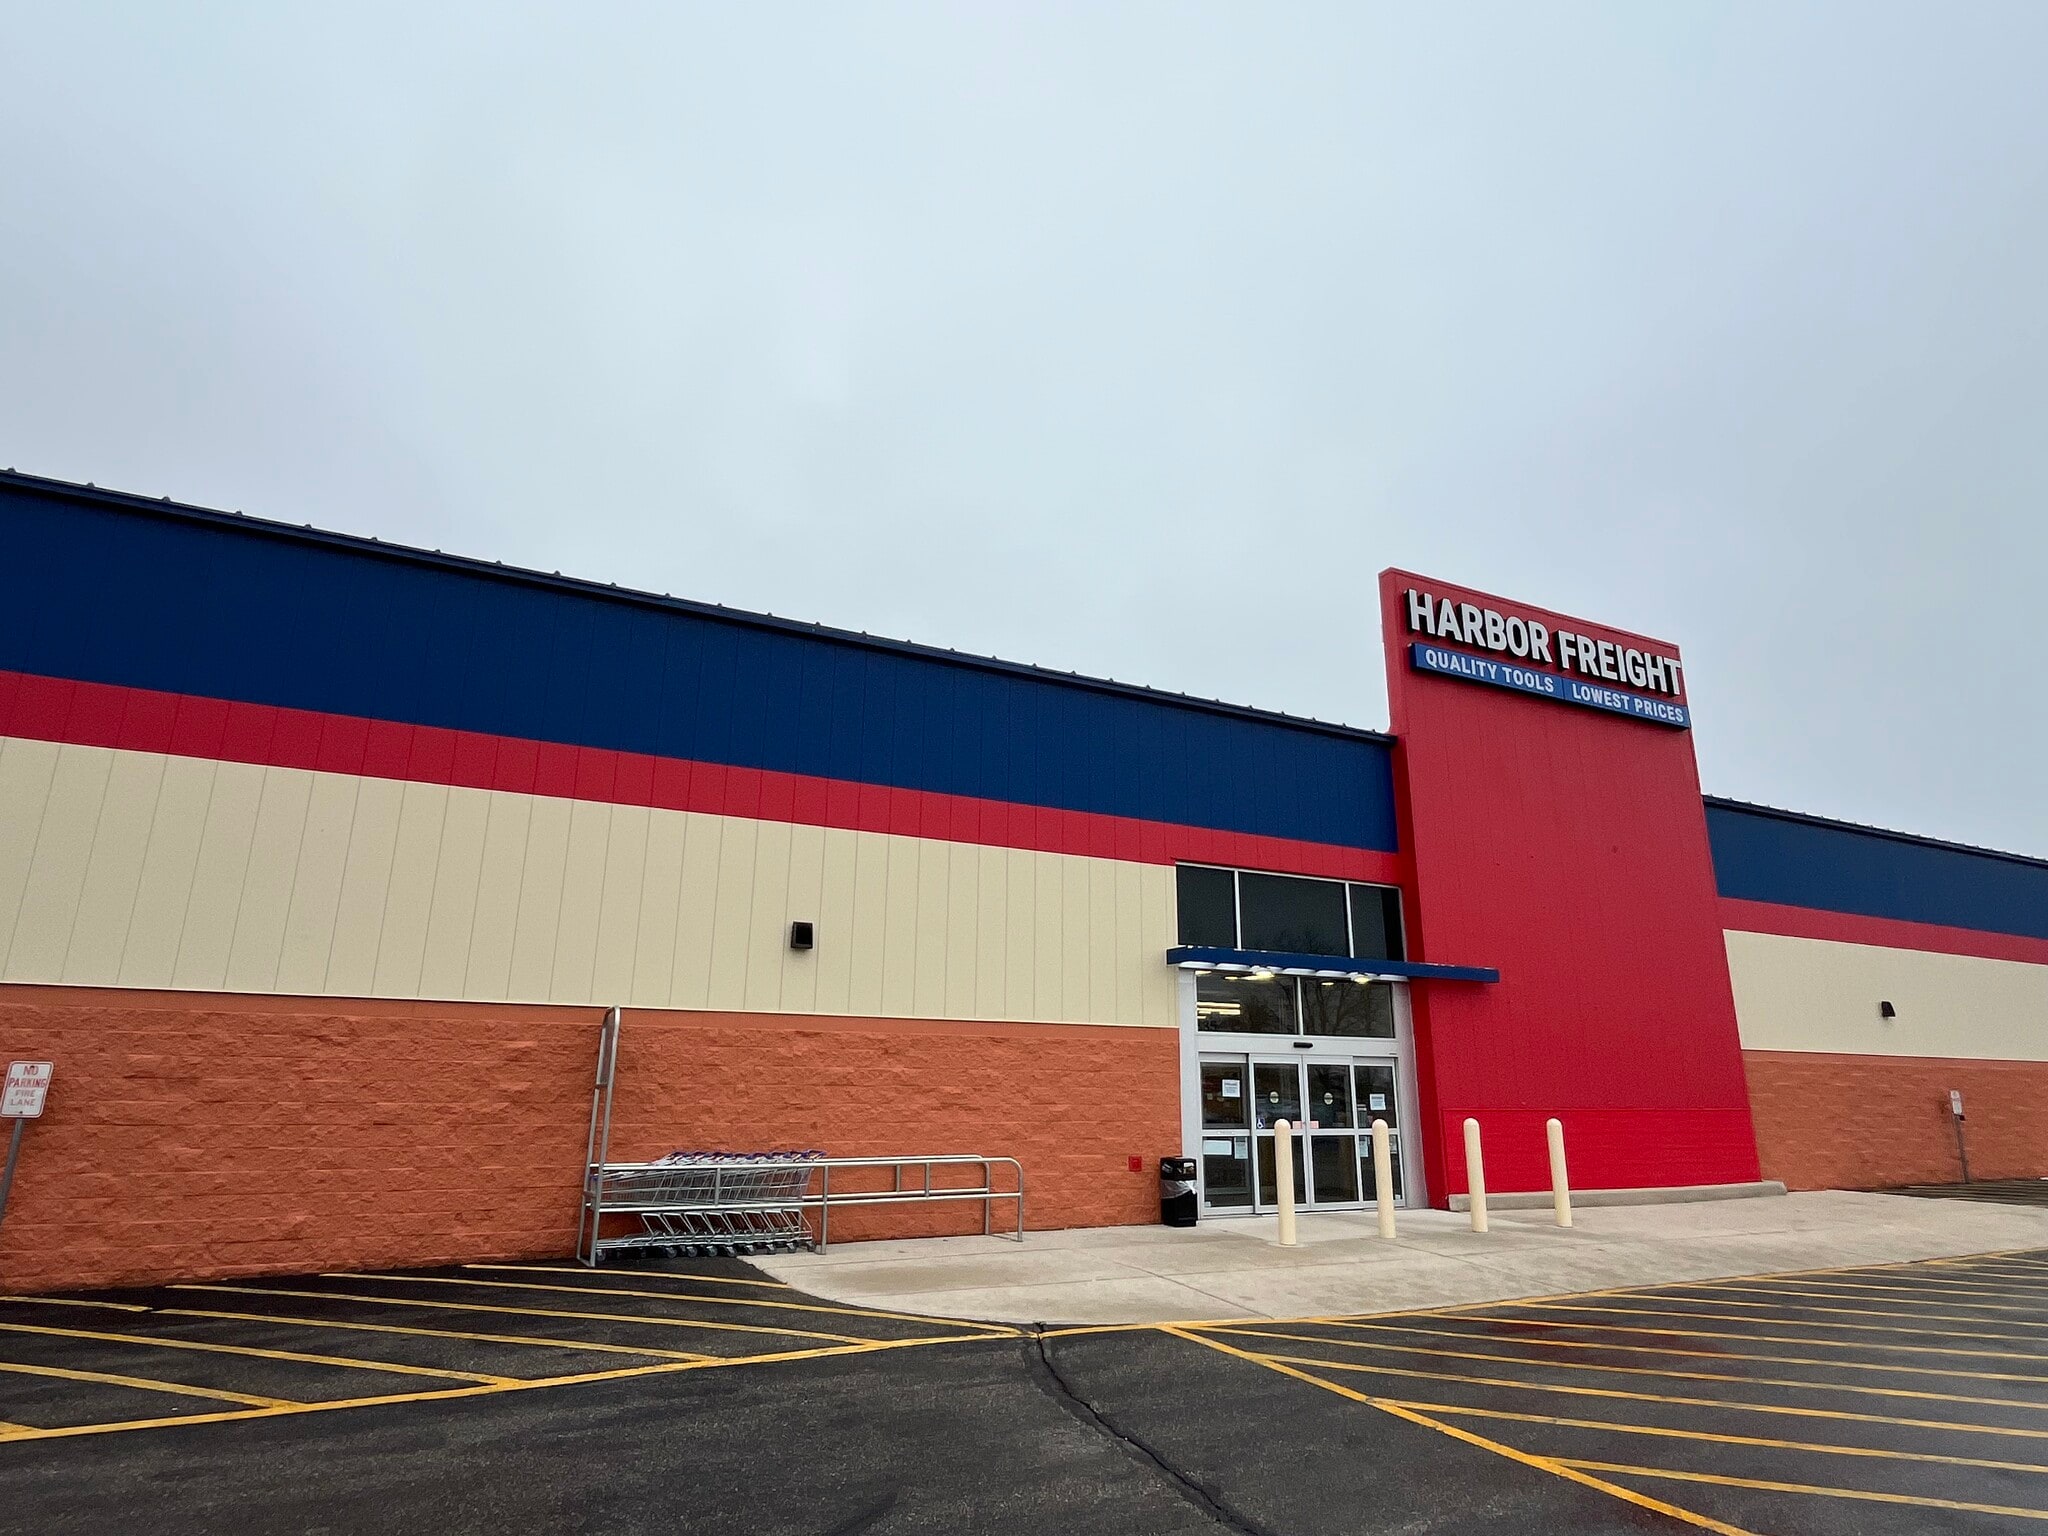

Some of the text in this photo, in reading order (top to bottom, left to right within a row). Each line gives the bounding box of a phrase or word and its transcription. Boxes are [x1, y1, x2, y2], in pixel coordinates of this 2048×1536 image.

[1407, 588, 1682, 695] HARBOR FREIGHT
[1425, 649, 1684, 723] QUALITY TOOLS LOWEST PRICES
[23, 1066, 39, 1076] NO
[8, 1078, 47, 1088] PARKING
[15, 1089, 36, 1098] FIRE
[10, 1098, 36, 1107] LANE
